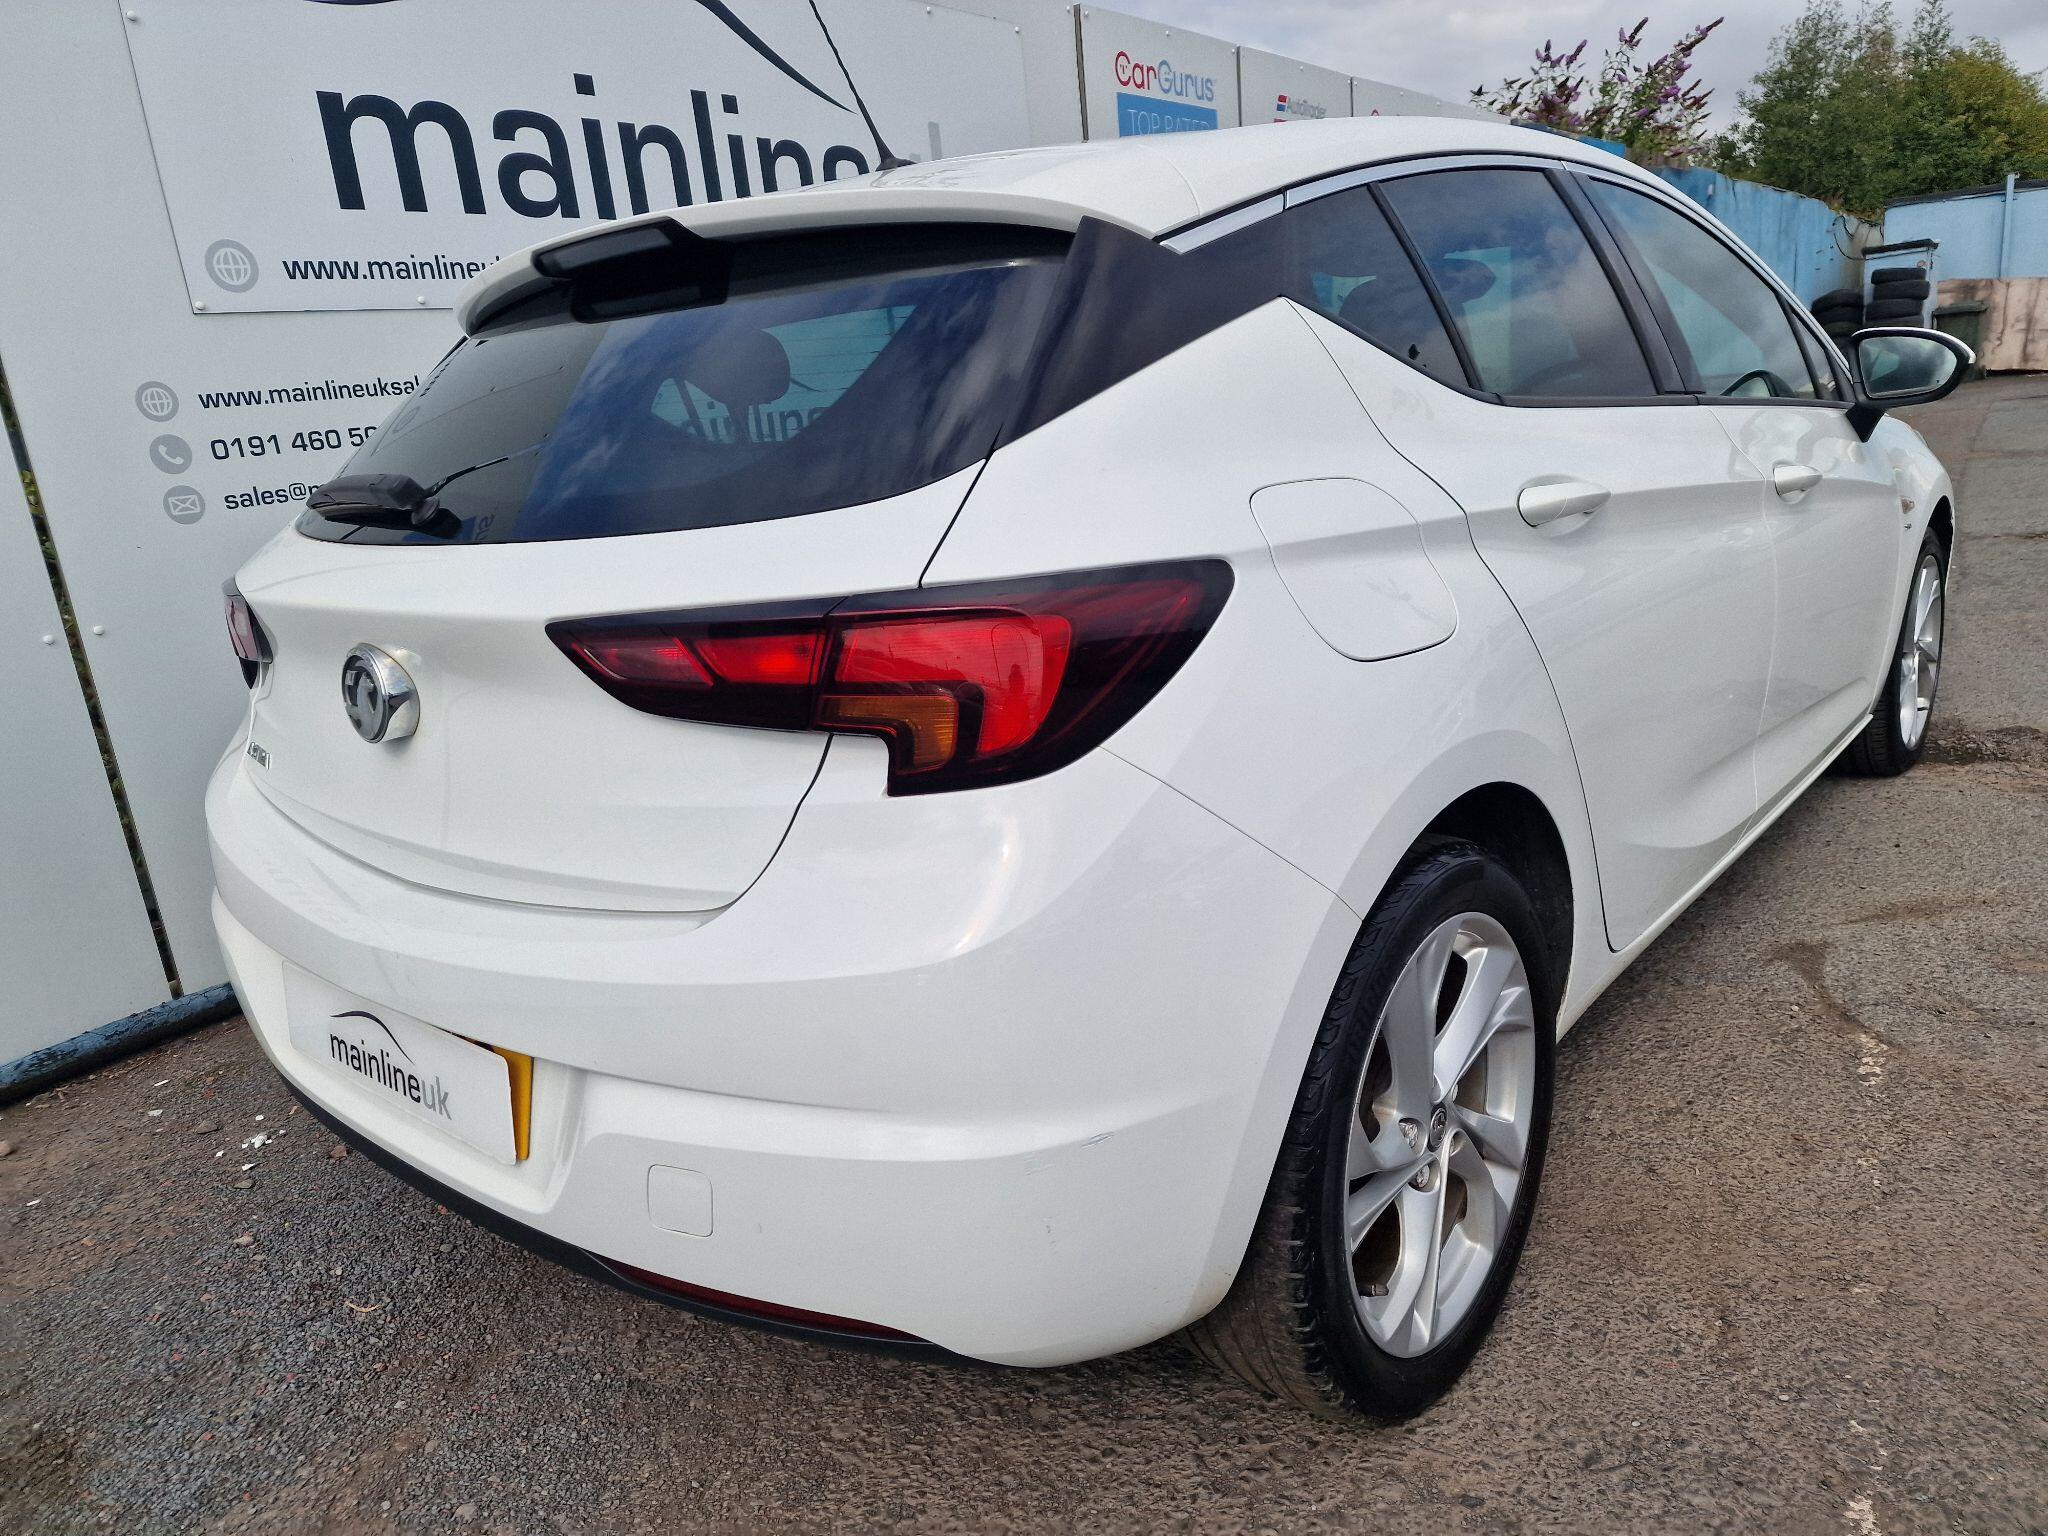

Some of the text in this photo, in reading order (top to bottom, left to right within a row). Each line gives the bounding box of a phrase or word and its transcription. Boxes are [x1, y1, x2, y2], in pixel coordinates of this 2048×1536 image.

[1115, 51, 1214, 102] CarGurus
[1128, 109, 1161, 136] TOP
[282, 254, 500, 280] www.mainline
[210, 434, 281, 460] 0191
[291, 429, 342, 452] 460
[330, 1033, 452, 1121] mainlineuk
